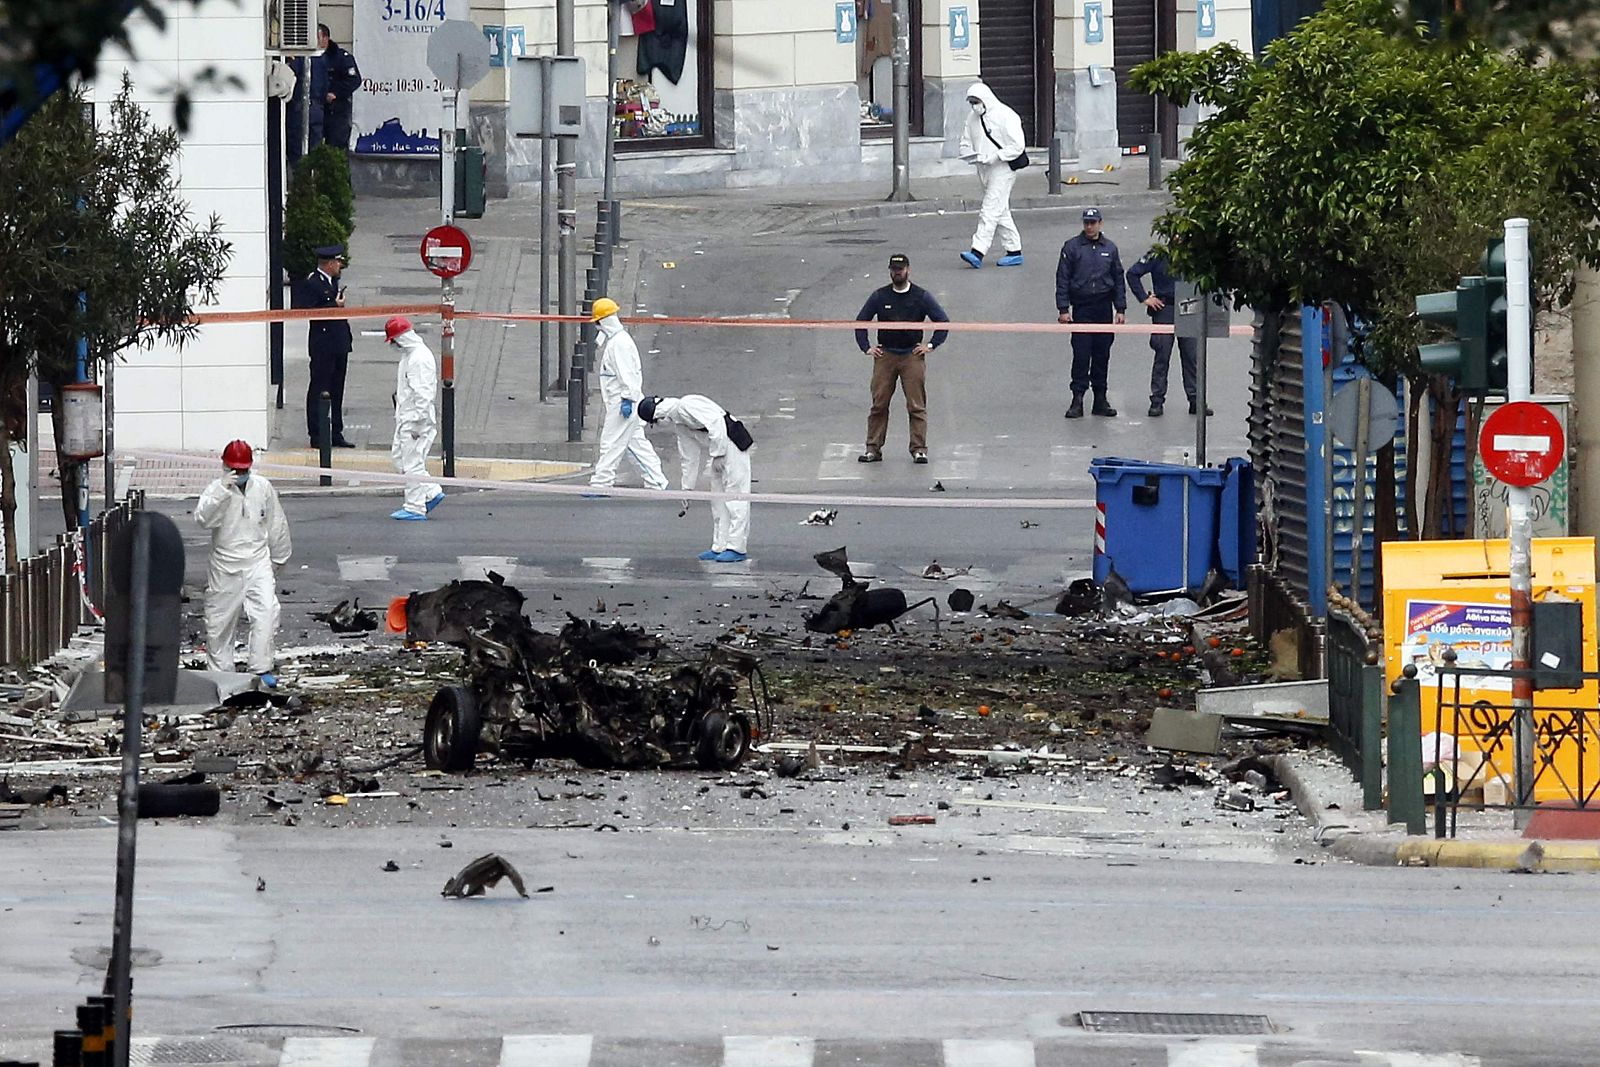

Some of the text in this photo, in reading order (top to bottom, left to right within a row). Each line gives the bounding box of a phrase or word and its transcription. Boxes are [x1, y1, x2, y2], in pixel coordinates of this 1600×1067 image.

[382, 0, 446, 21] 3-16/4
[396, 79, 423, 92] 10:30
[1465, 613, 1490, 622] Αθήνα
[1431, 624, 1511, 637] εδώ μόνο ανακύκλ
